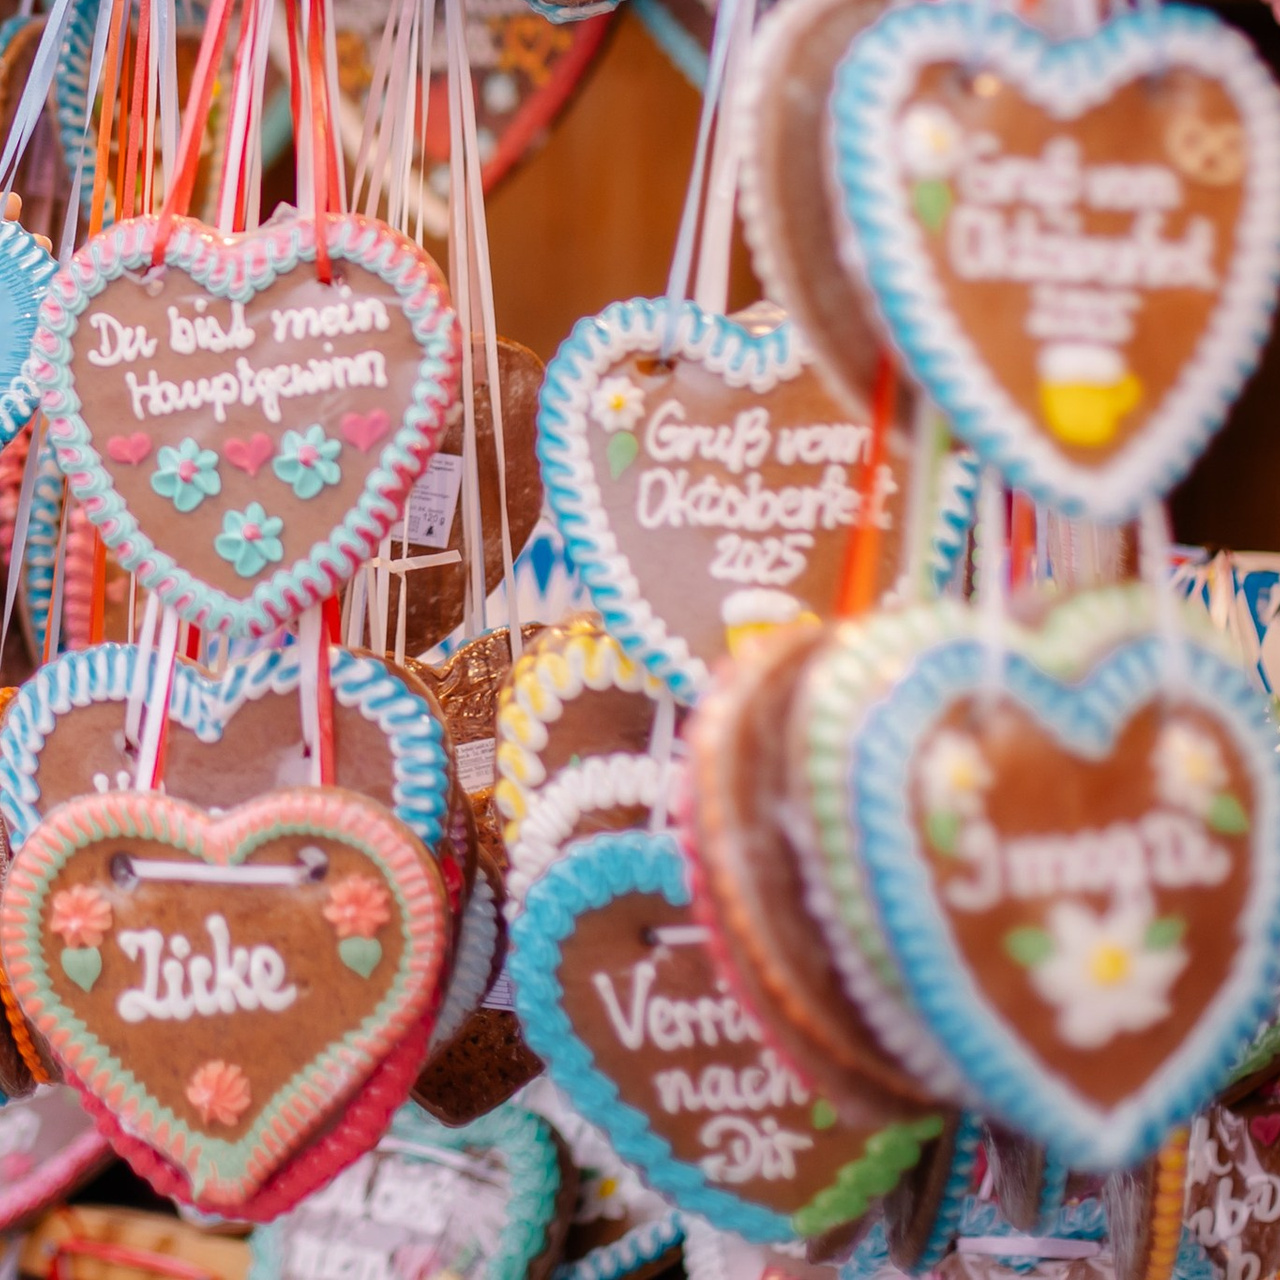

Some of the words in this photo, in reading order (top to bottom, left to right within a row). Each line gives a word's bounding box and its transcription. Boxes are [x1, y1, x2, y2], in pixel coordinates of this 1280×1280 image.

[87, 312, 158, 367] Du
[167, 298, 256, 355] bist
[271, 284, 391, 343] mein
[125, 341, 388, 423] Hauptgewinn
[645, 399, 772, 474] Gruß
[776, 422, 873, 466] vom
[637, 464, 899, 531] Oktoberfet
[709, 532, 815, 587] 2025
[117, 912, 298, 1024] Zicke
[591, 961, 763, 1052] Verrü
[653, 1047, 810, 1115] nach
[698, 1116, 815, 1183] Dir
